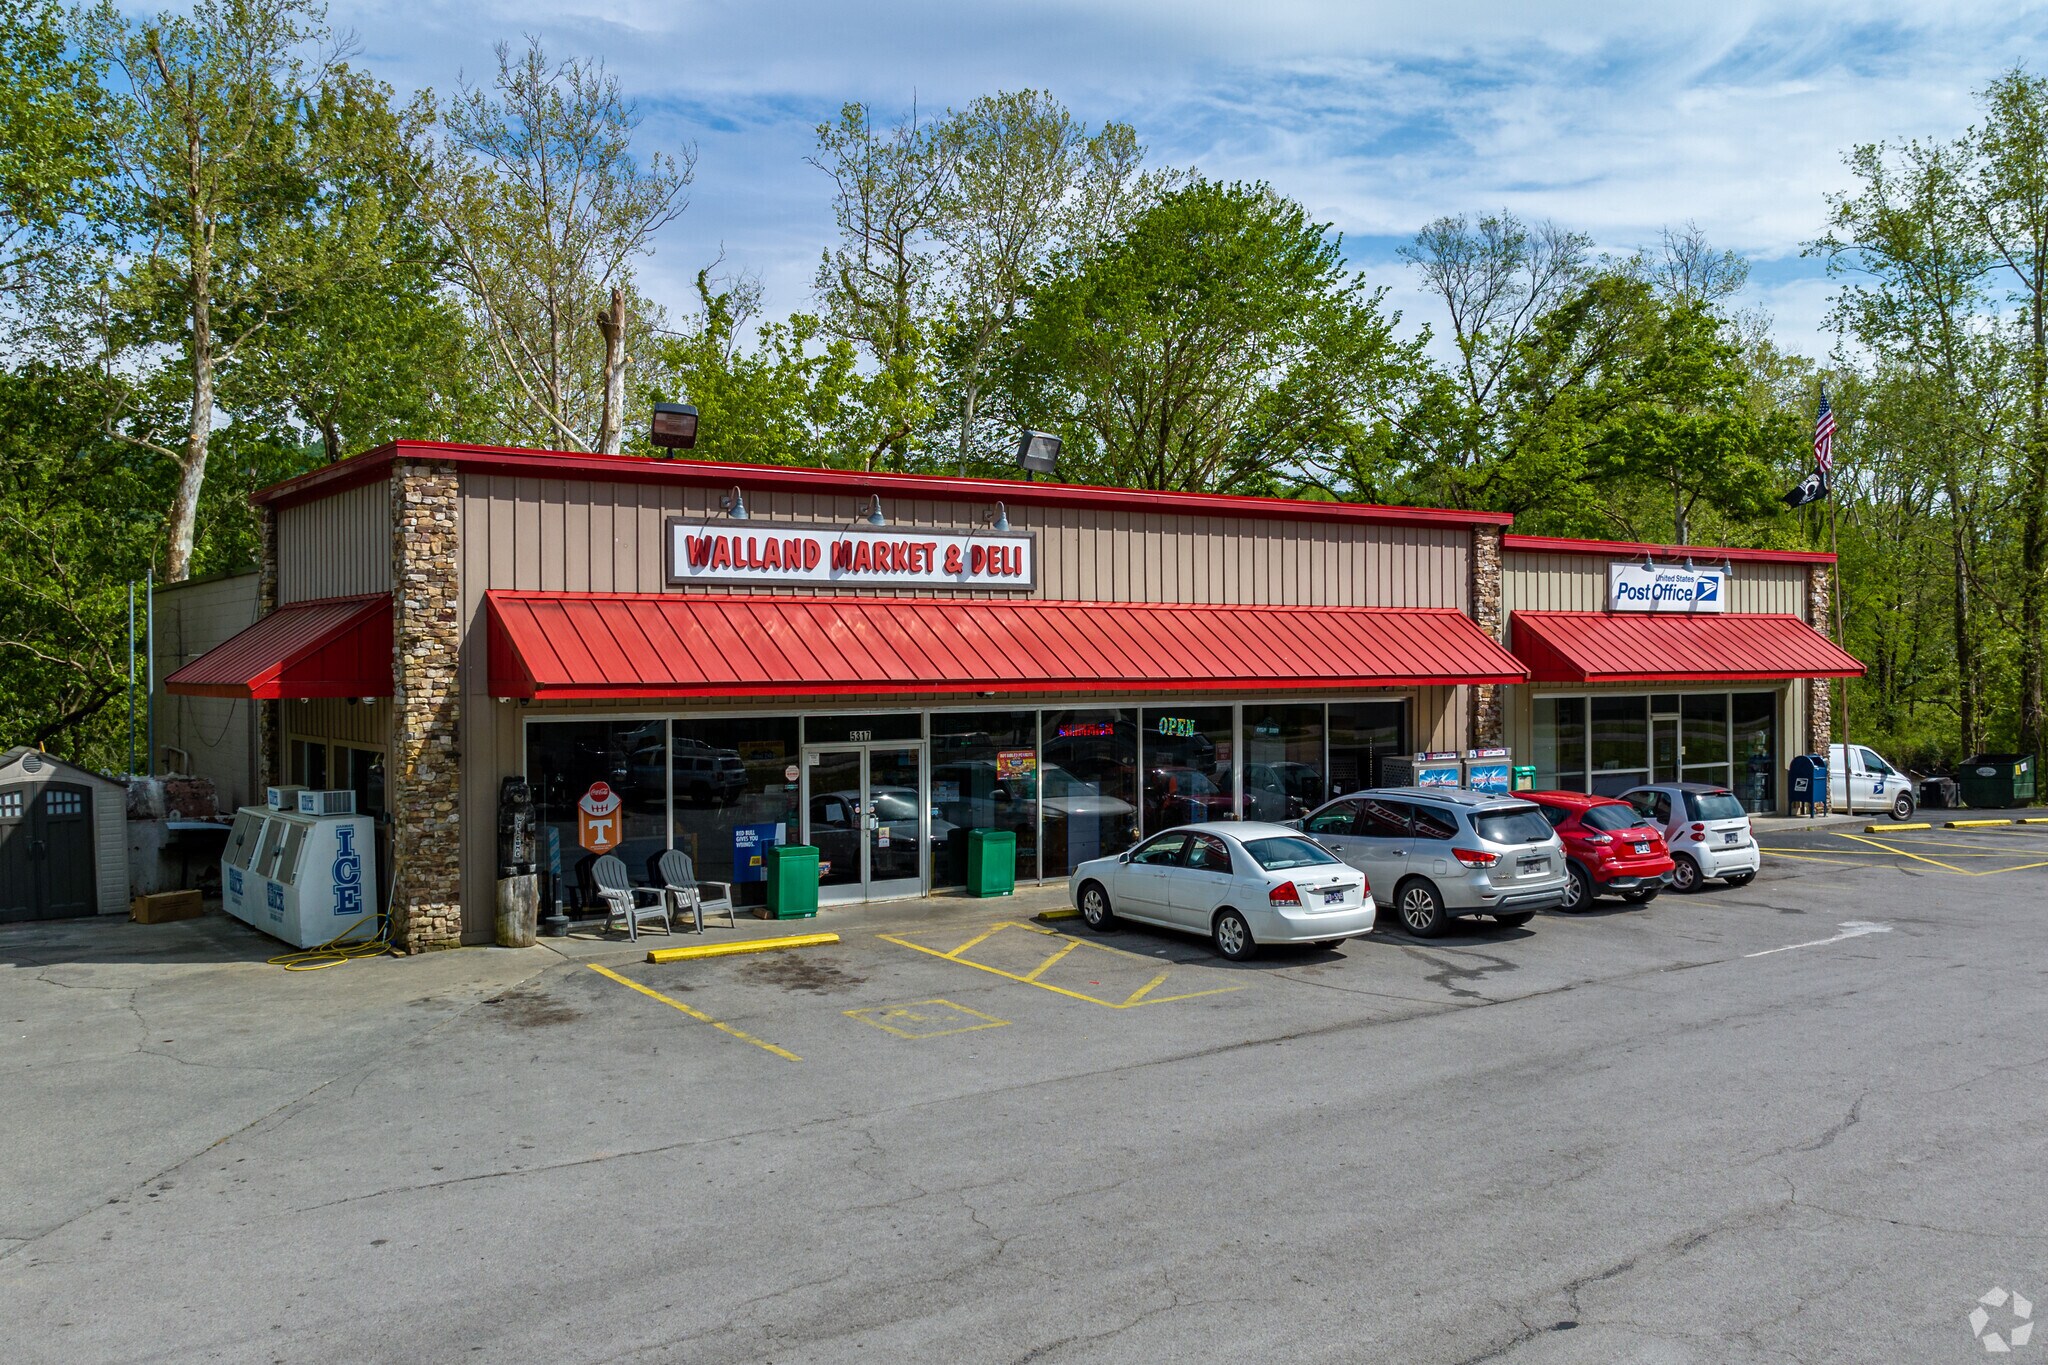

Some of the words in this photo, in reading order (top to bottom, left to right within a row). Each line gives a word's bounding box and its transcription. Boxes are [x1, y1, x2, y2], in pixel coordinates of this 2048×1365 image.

[686, 534, 822, 571] WALLAND
[831, 538, 938, 574] MARKET
[943, 542, 963, 575] &
[971, 543, 1023, 576] DELI
[1655, 573, 1676, 583] United
[1676, 574, 1695, 583] States
[1617, 582, 1651, 601] Post
[1651, 583, 1693, 602] Office
[850, 731, 872, 742] 5317
[1158, 716, 1196, 737] OPEN
[588, 818, 613, 845] T
[332, 828, 363, 917] ICE
